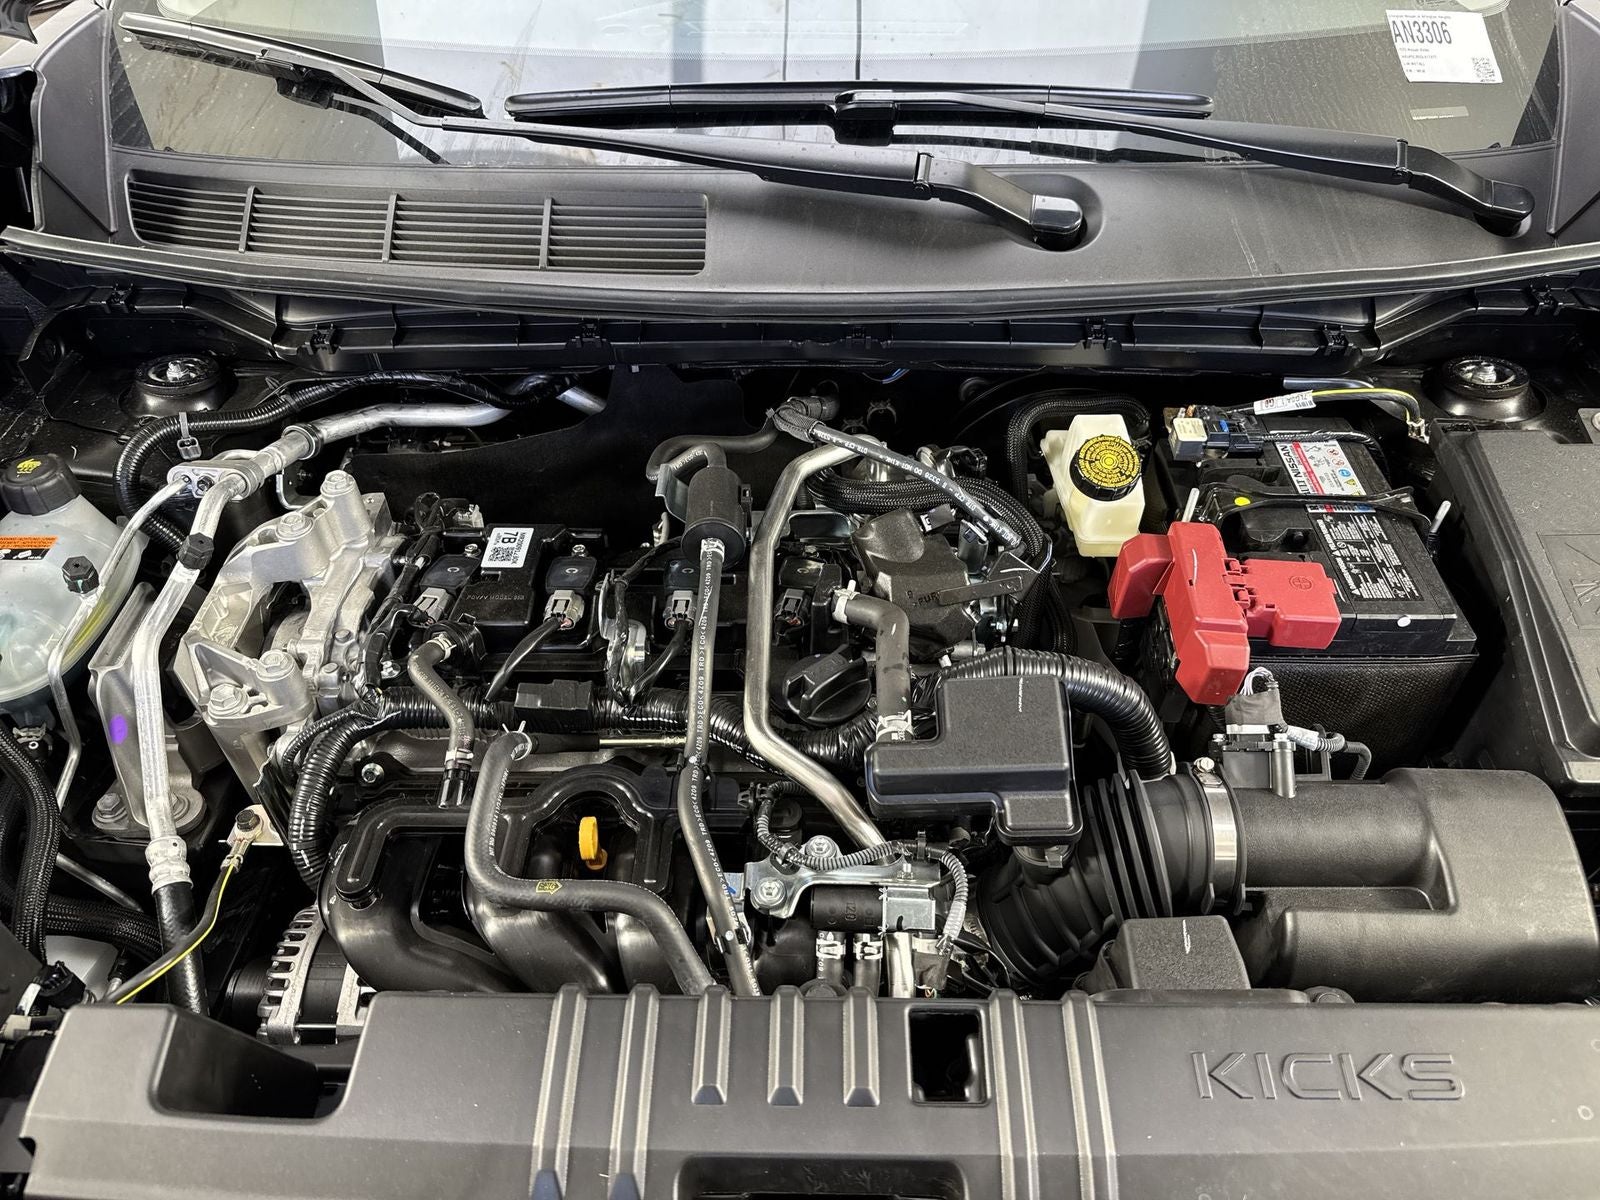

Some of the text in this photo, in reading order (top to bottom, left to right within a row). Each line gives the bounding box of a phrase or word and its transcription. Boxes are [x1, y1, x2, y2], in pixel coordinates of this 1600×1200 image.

[1391, 20, 1452, 44] AN3306
[1280, 446, 1302, 478] NISSAN
[502, 531, 518, 543] 7B
[1192, 1052, 1465, 1100] KICKS
